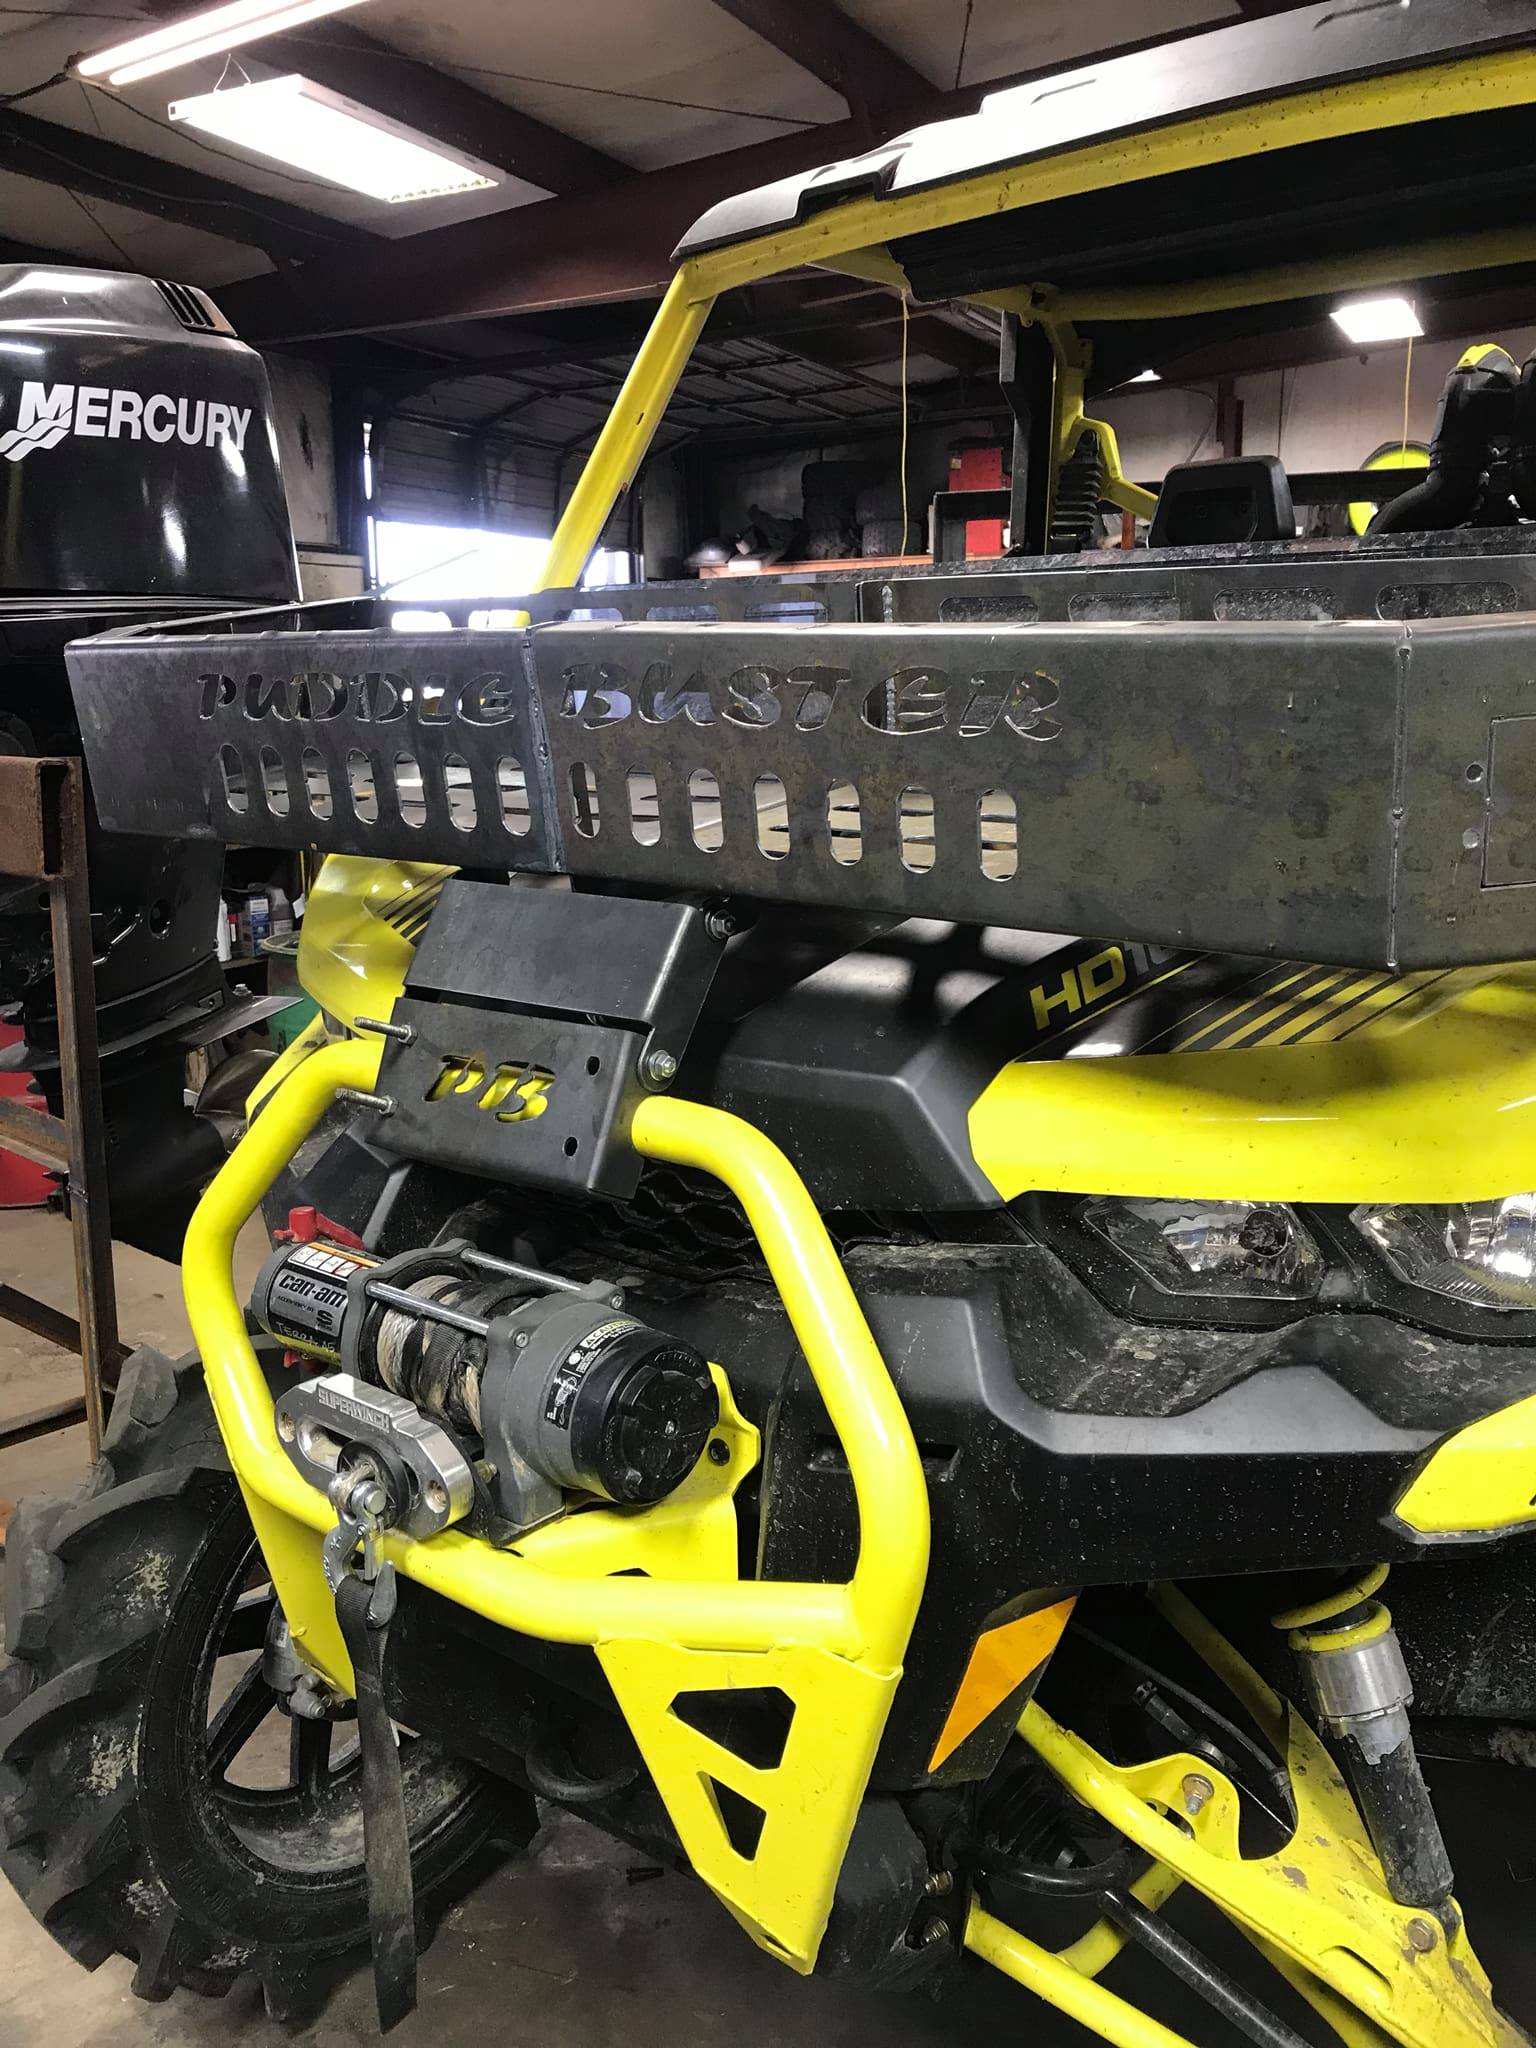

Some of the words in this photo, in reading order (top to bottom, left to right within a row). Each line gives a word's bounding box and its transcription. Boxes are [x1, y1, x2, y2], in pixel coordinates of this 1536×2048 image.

[16, 381, 252, 451] MERCURY
[197, 671, 515, 727] PUDDLE
[559, 661, 1064, 742] BUSTER
[422, 1054, 556, 1123] PB
[279, 1274, 347, 1309] can-am
[318, 1389, 390, 1434] SUPERWINCH
